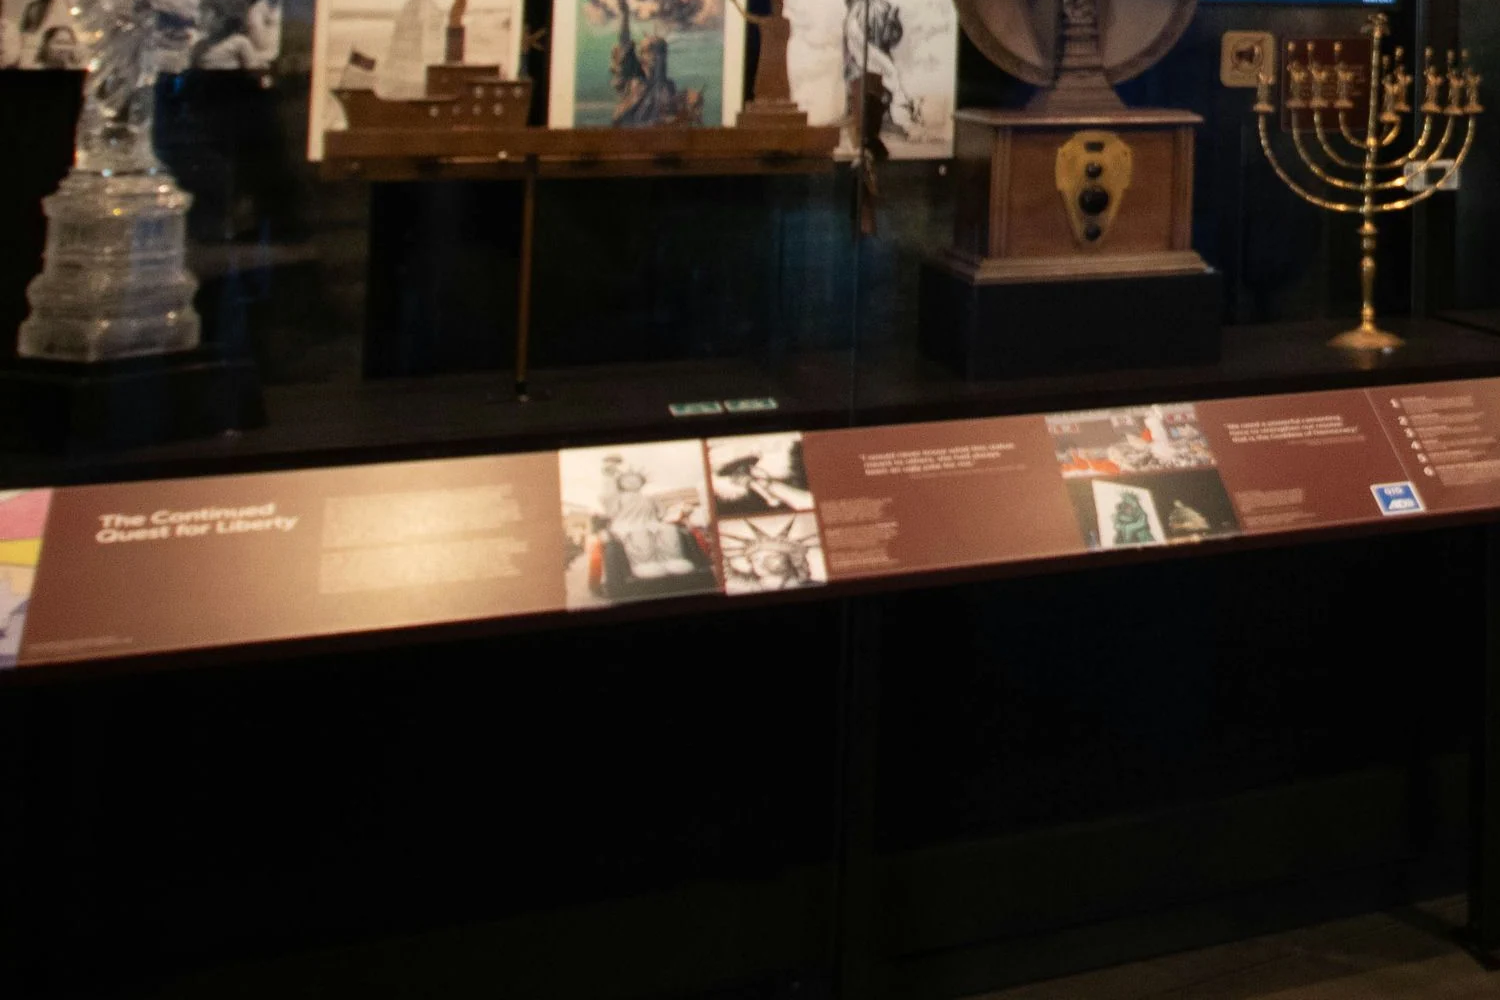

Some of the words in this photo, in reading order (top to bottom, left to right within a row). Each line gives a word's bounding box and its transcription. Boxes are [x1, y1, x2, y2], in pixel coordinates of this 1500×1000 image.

[100, 513, 147, 528] The
[150, 502, 276, 526] Continued
[95, 525, 170, 543] Quest
[174, 523, 212, 538] for
[215, 515, 300, 533] Liberty
